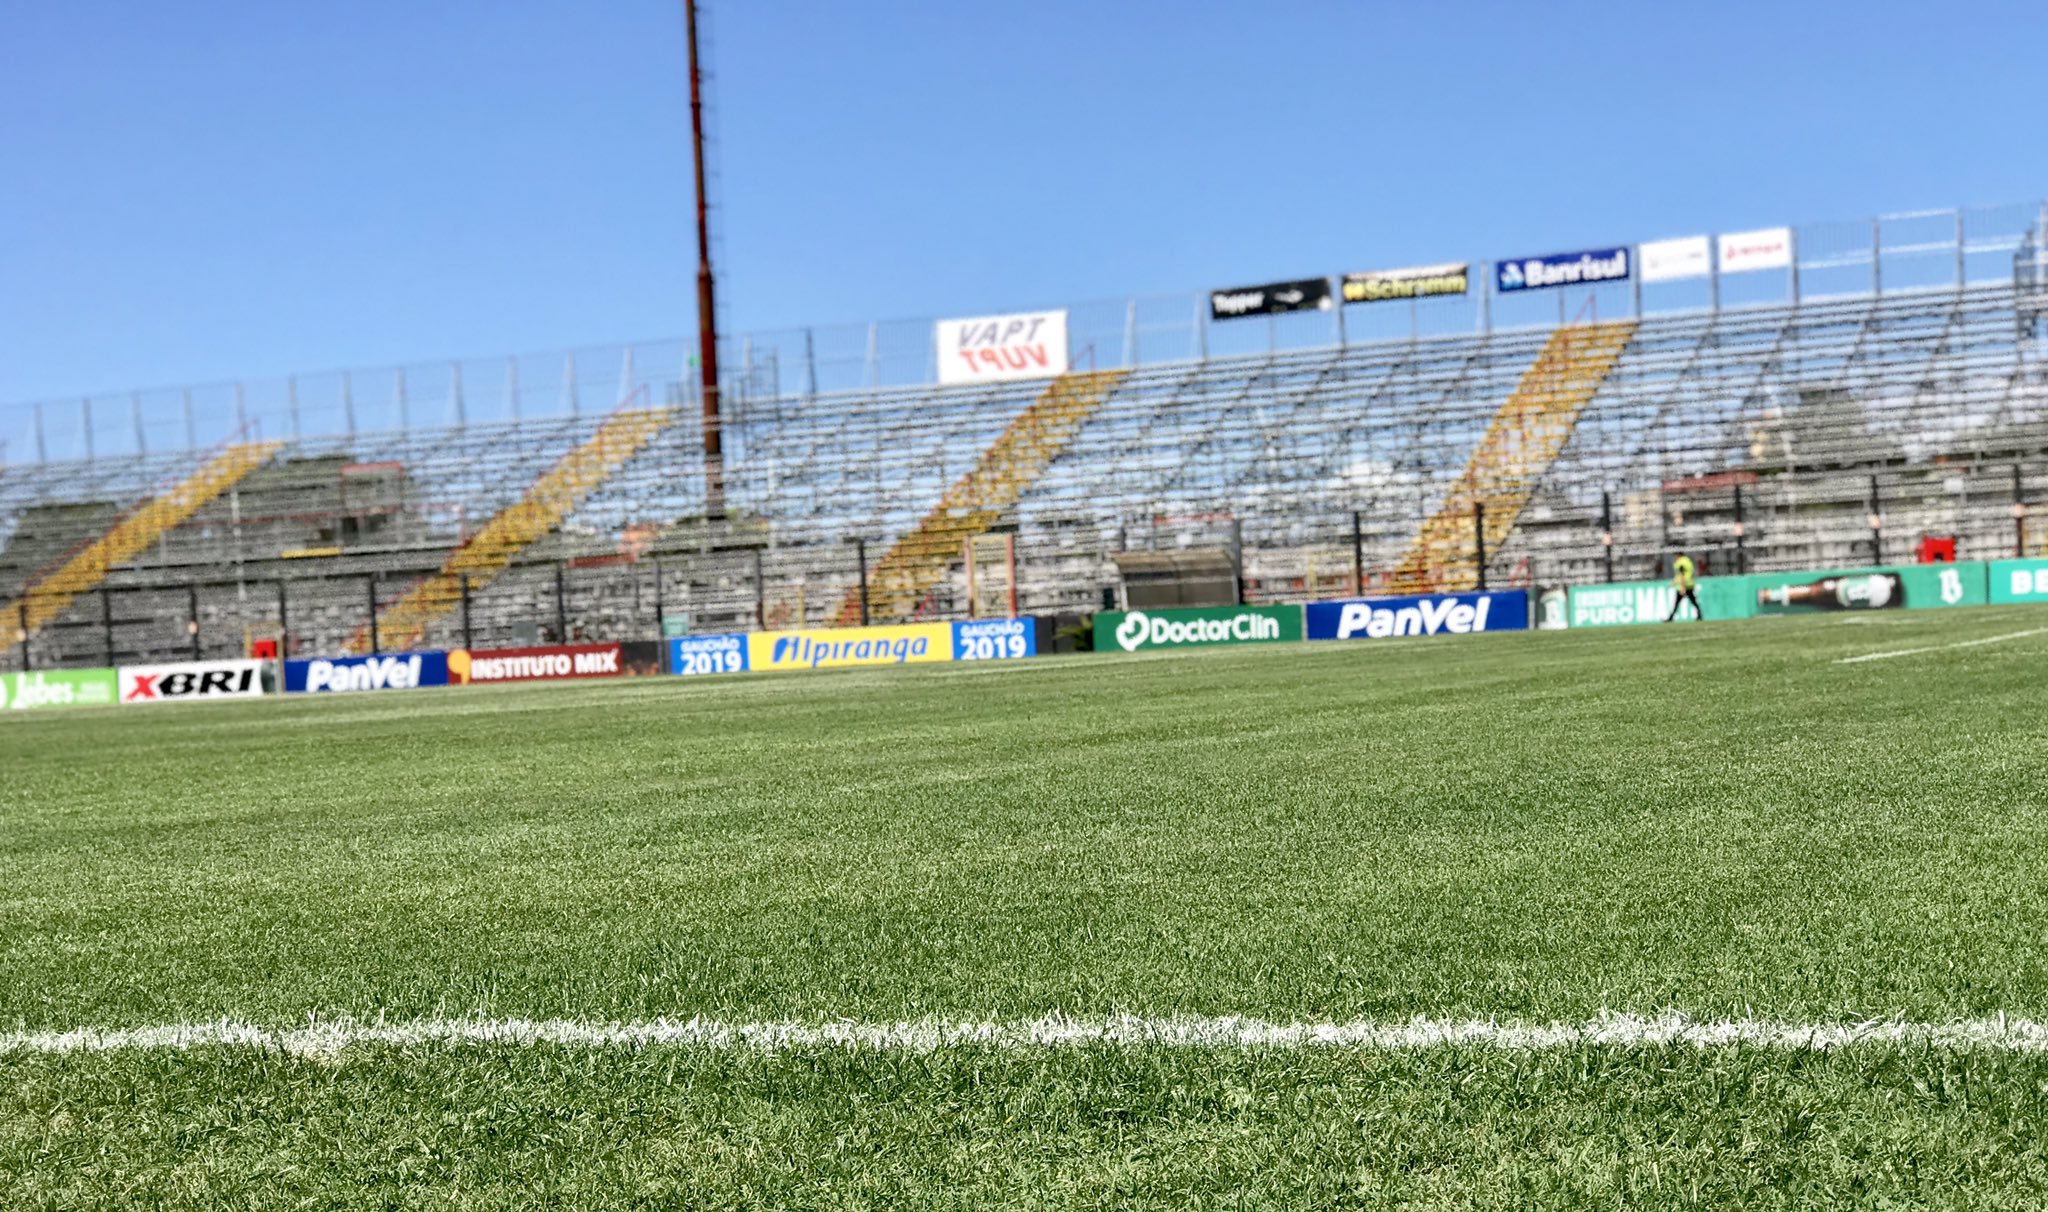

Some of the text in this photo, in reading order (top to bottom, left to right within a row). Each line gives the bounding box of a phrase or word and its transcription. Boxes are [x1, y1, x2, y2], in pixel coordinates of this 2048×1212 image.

[1524, 248, 1627, 287] Banrisul
[959, 317, 1046, 347] VAPT
[1337, 597, 1491, 639] PanVel
[1575, 607, 1634, 626] PURO
[1636, 584, 1702, 621] MAL
[1151, 613, 1280, 644] DoctorClin
[680, 650, 743, 675] 2019
[803, 636, 928, 668] Ipiranga
[960, 635, 1027, 660] 2019
[306, 655, 422, 692] PanVel
[470, 648, 620, 680] INSTITUTO MIX
